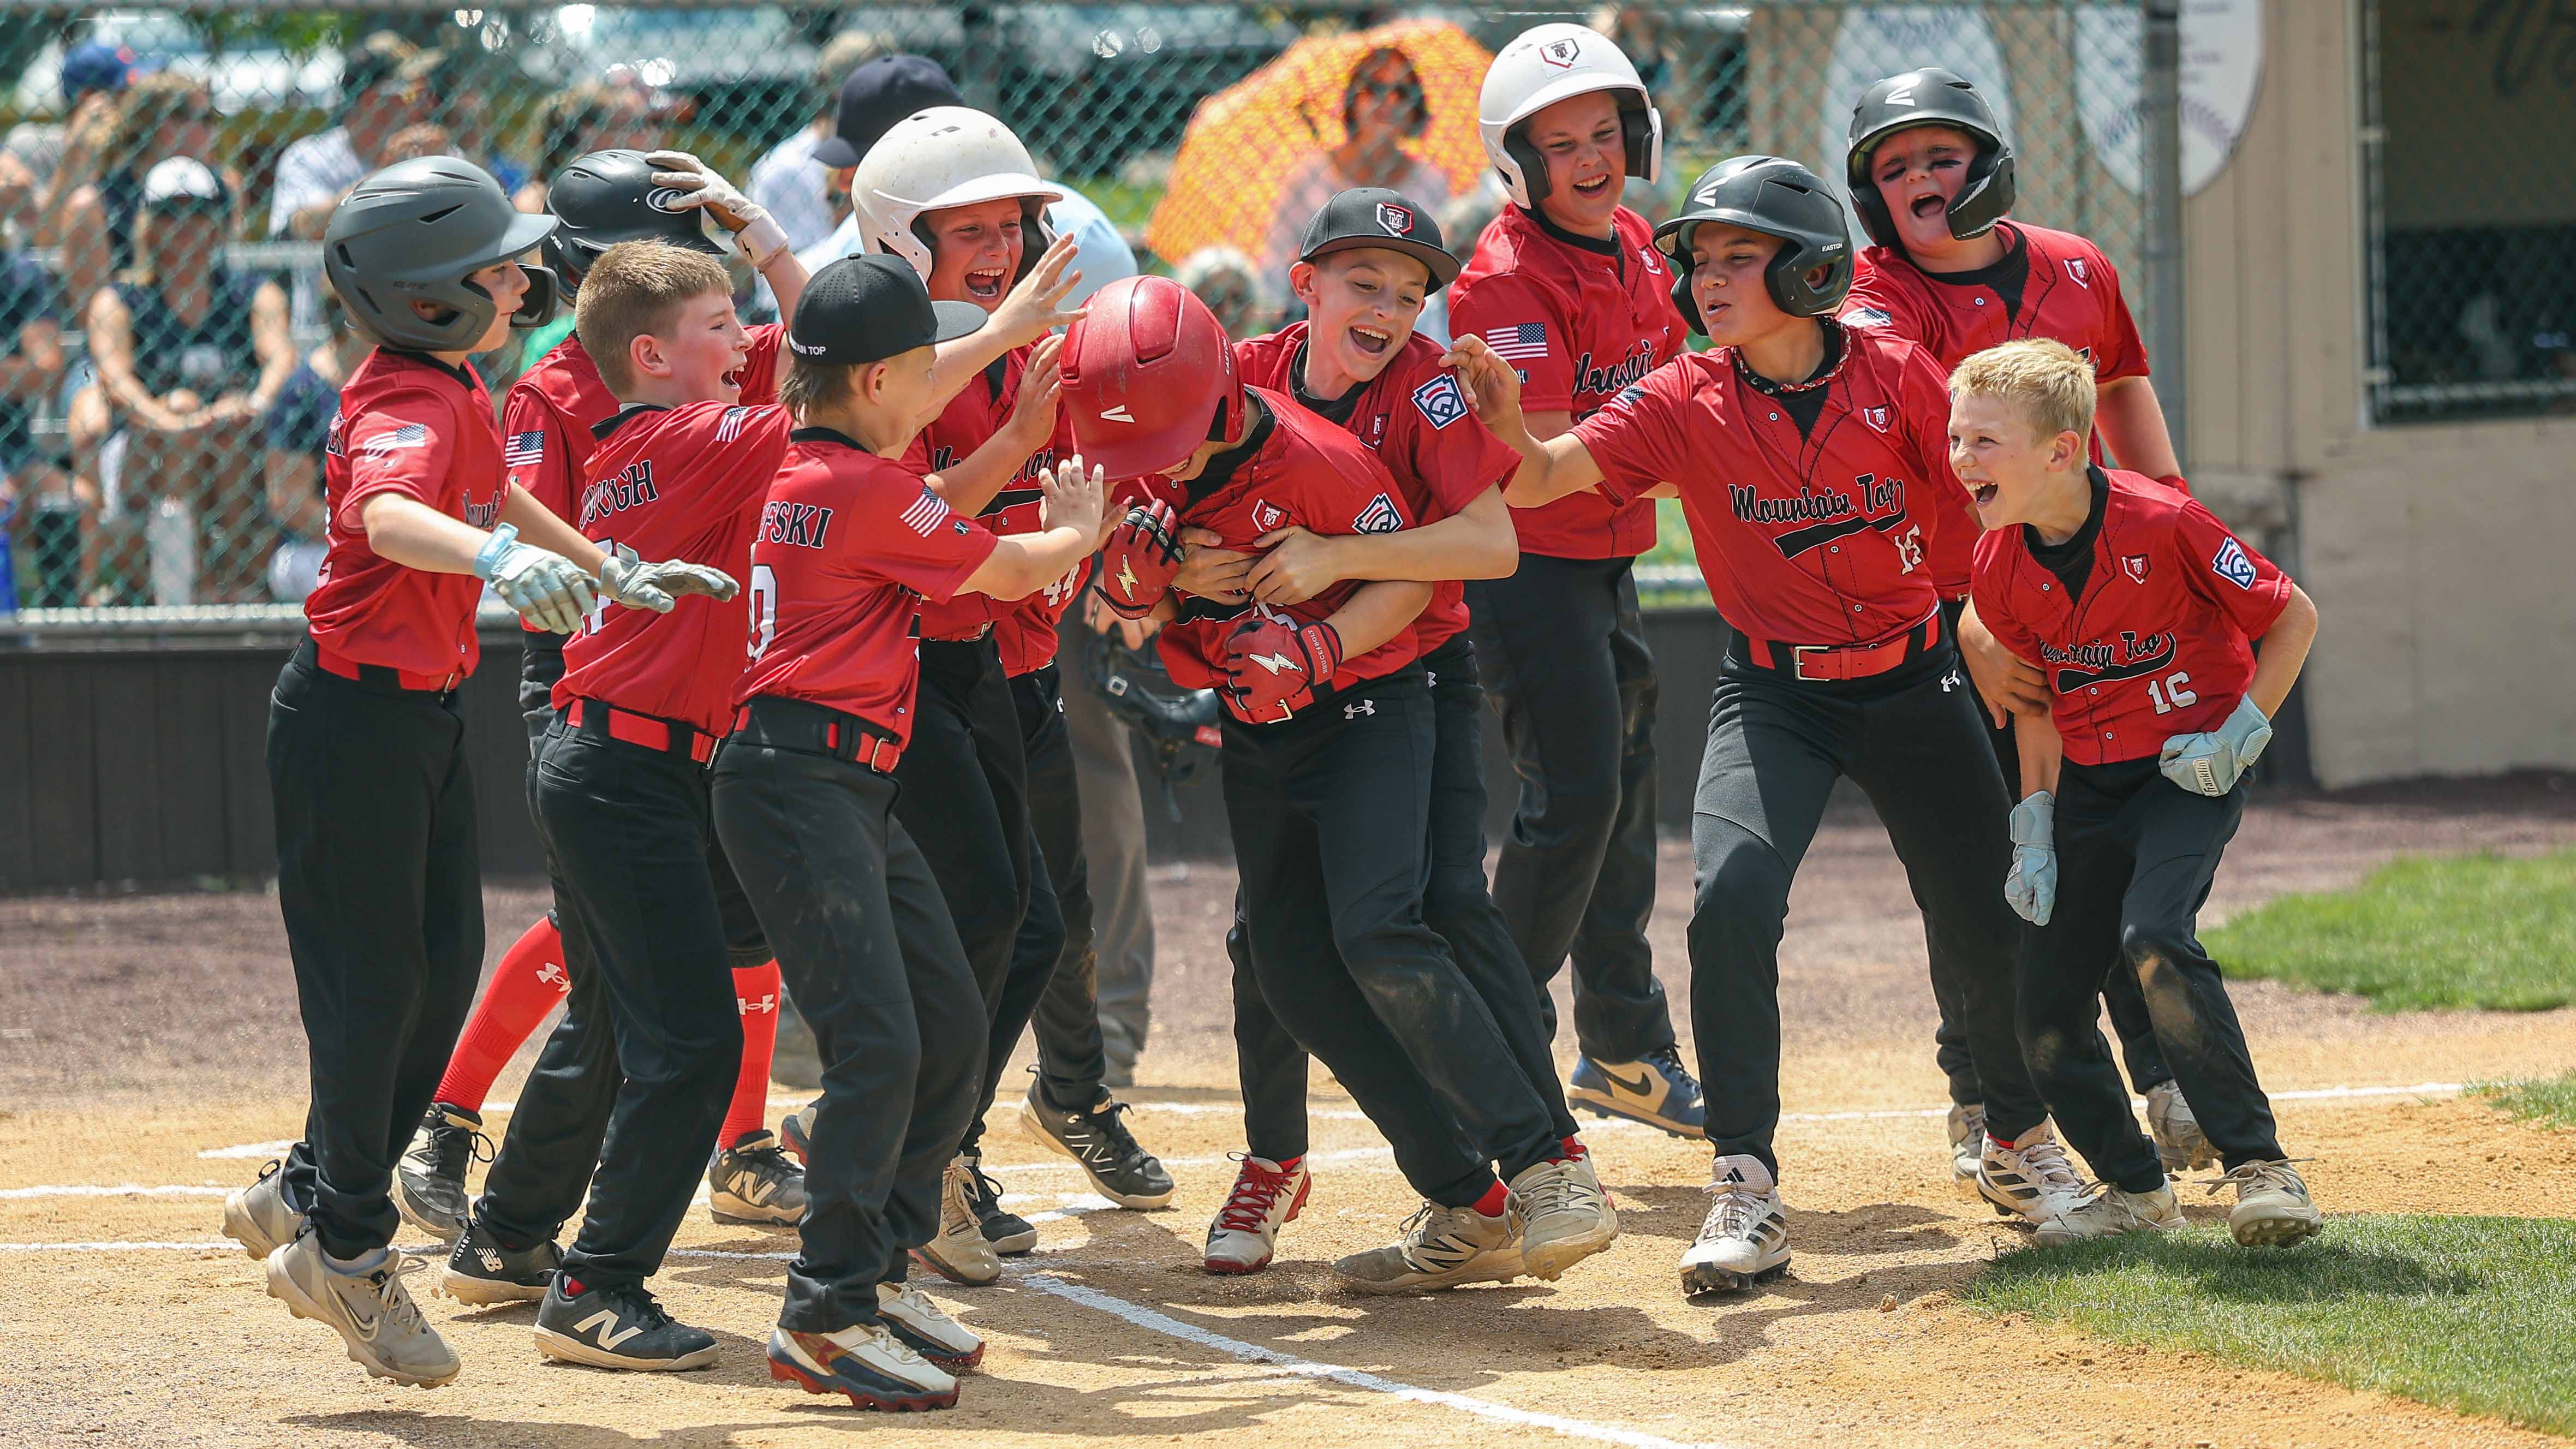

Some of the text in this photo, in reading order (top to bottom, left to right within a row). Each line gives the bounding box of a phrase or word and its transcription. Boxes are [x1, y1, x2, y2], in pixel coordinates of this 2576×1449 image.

[1822, 242, 1843, 252] EASTON
[808, 346, 826, 355] TOP
[1728, 473, 1901, 524] Mountain Top
[1894, 523, 1923, 575] 15
[1043, 563, 1080, 607] 44
